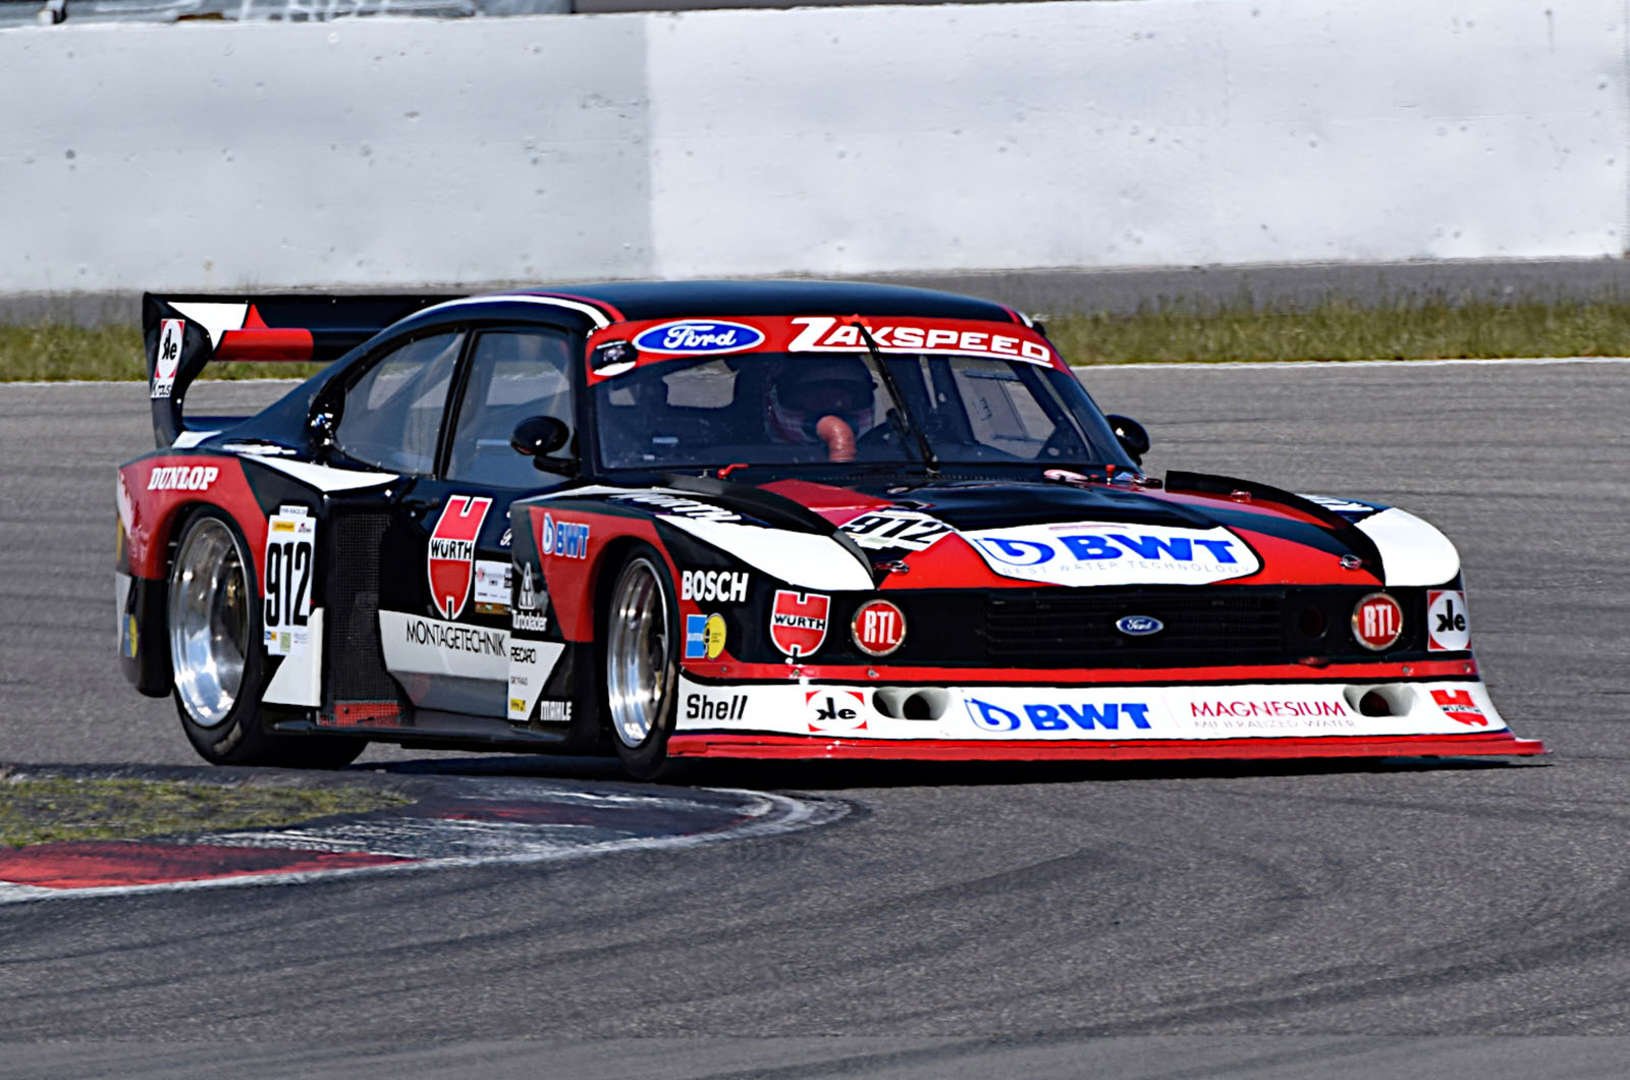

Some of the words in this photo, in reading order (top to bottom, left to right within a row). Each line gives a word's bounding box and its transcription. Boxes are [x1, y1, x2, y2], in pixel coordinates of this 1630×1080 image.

[663, 325, 737, 349] Ford
[788, 316, 1053, 366] ZAKSPEED
[147, 466, 219, 491] DUNLOP
[555, 521, 590, 559] BWT
[841, 515, 953, 544] 912
[431, 538, 472, 560] WÜRTH
[1060, 534, 1238, 564] BWT
[265, 541, 312, 627] 912
[681, 570, 749, 602] BOSCH
[863, 610, 899, 645] RTL
[1126, 619, 1153, 631] Ford
[1363, 604, 1396, 638] RTL
[406, 619, 507, 657] MONTAGETECHNIK
[686, 694, 748, 720] Shell
[1023, 703, 1152, 731] BWT
[1189, 701, 1347, 718] MAGNESIUM
